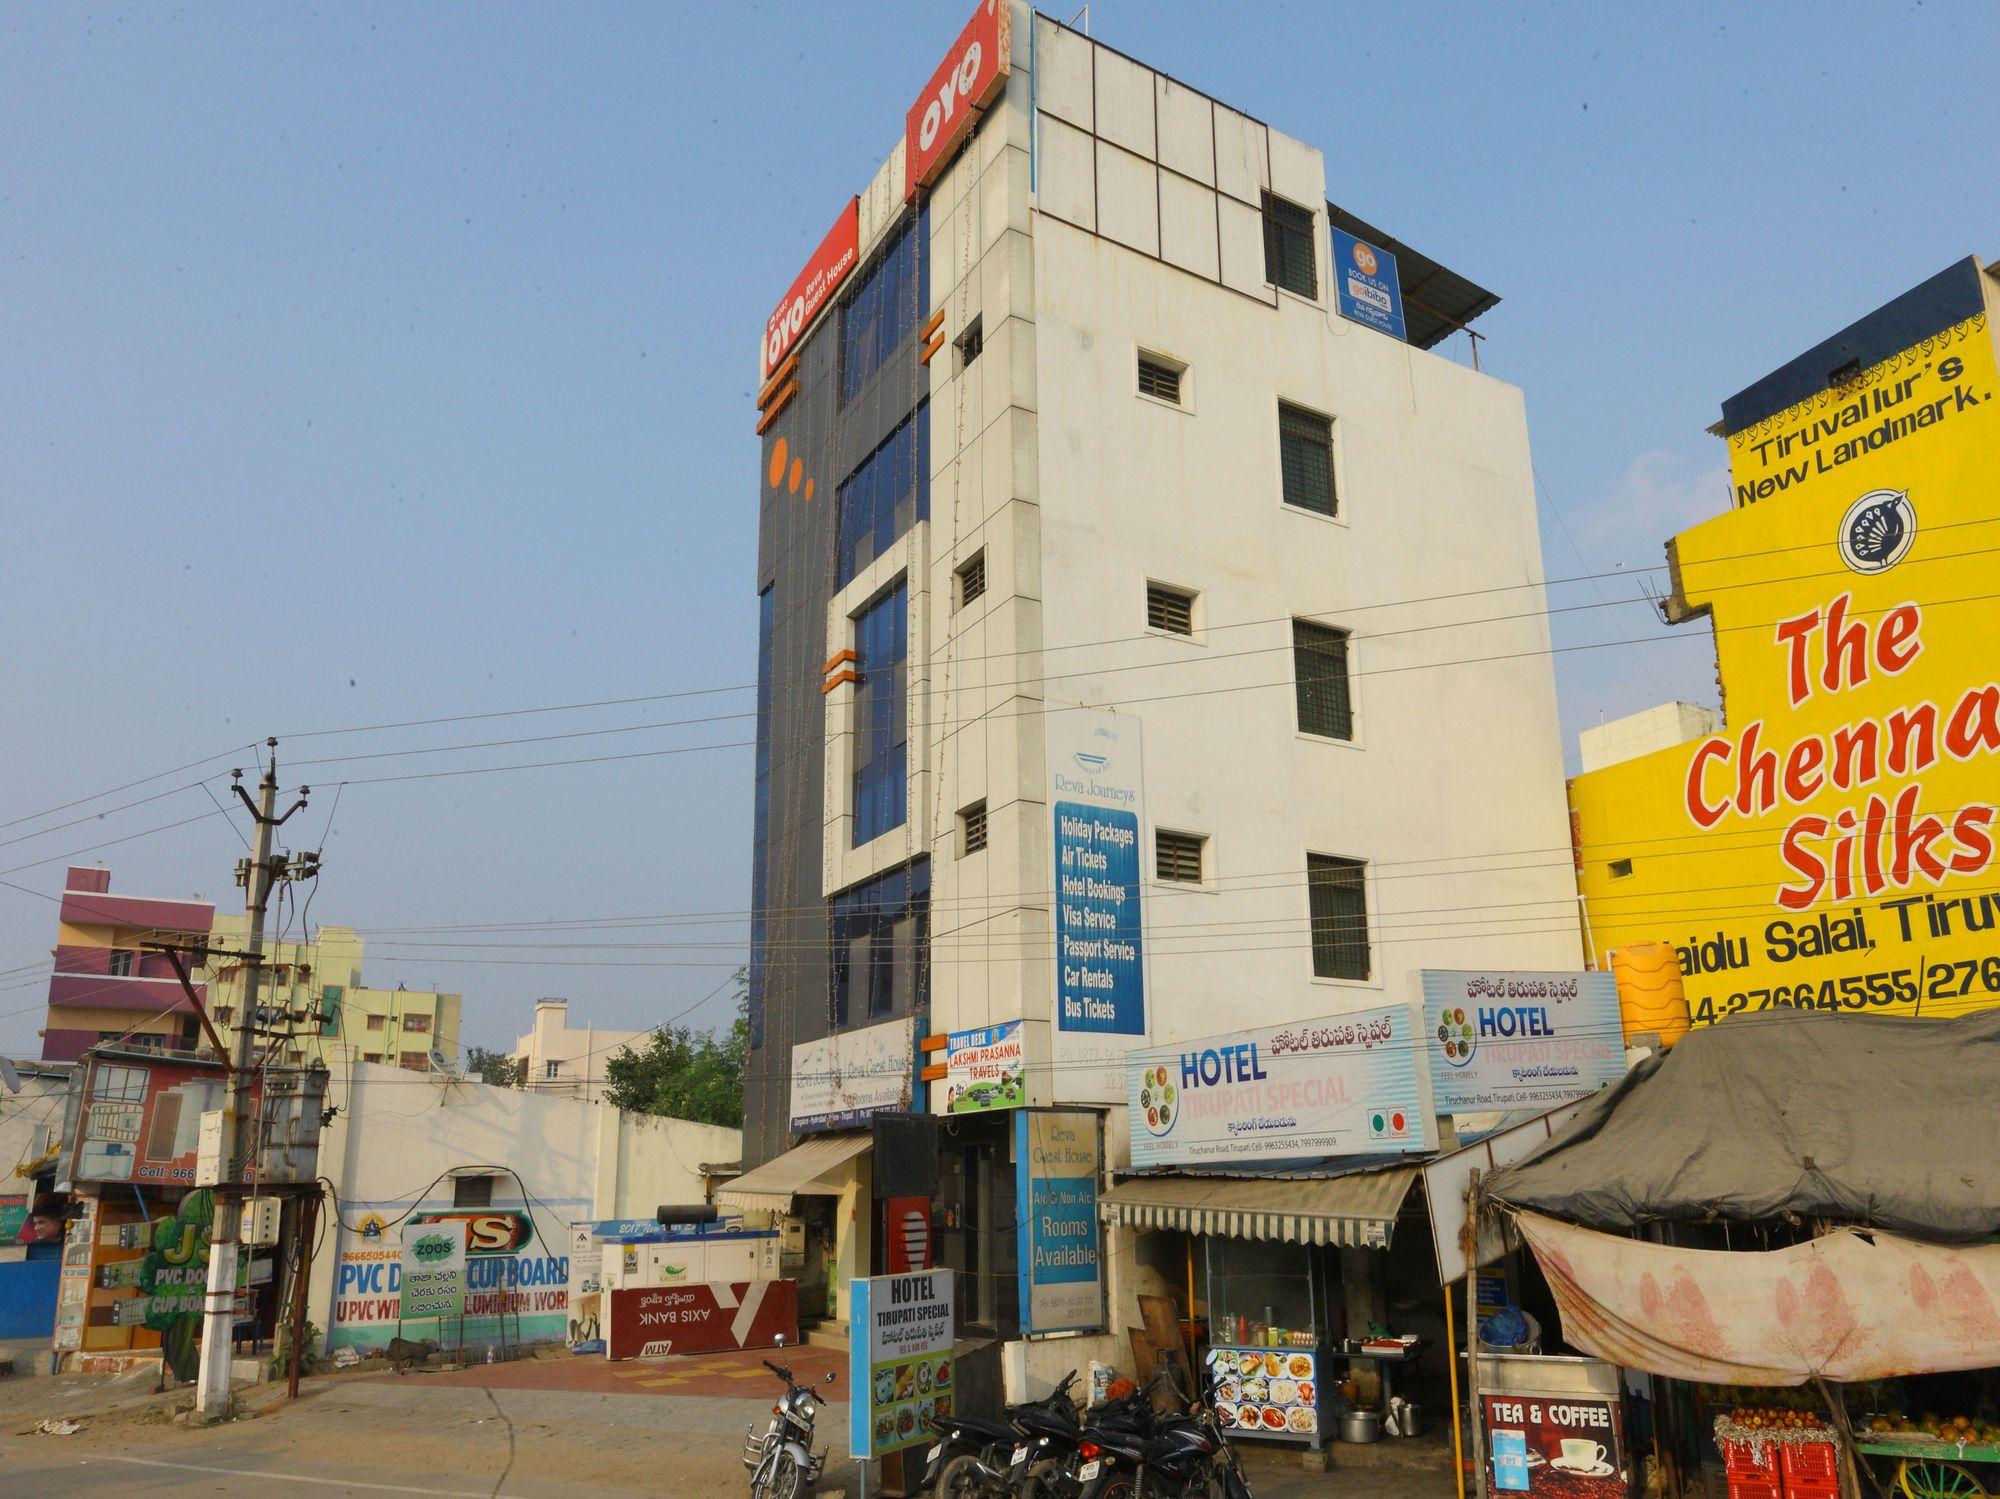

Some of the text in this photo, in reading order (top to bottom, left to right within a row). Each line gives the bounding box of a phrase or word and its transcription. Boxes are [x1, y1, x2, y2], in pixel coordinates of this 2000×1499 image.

[919, 41, 982, 152] OYO
[805, 247, 853, 316] Guest House
[768, 295, 805, 365] OYO
[1750, 356, 1965, 467] Tiruvallur's
[1737, 384, 1992, 508] New Landmark.
[1776, 592, 1923, 709] The
[1055, 773, 1135, 806] Reva Journeys
[1061, 815, 1134, 848] Holiday Packages
[1062, 845, 1107, 870] Air Tickets
[1774, 783, 1998, 911] Silks
[1062, 875, 1125, 905] Hotel Bookings
[1062, 904, 1116, 930] Visa Service
[1063, 935, 1135, 962] Passport Service
[1672, 931, 1750, 977] aidu
[1764, 907, 1876, 963] Salai,
[1064, 965, 1114, 990] Car Rentals
[1467, 977, 1506, 998] హోటల్
[1508, 981, 1547, 998] తిరుపతి
[1065, 996, 1115, 1020] Bus Tickets
[1479, 1007, 1555, 1037] HOTEL
[950, 1034, 969, 1050] TRAVEL
[1271, 1029, 1309, 1055] హోటల్
[1311, 1025, 1355, 1050] తిరుపతి
[1483, 1042, 1552, 1063] TIRUPATI
[949, 1043, 1021, 1067] LAKSHMI PRASANNA
[1180, 1042, 1267, 1090] HOTEL
[969, 1063, 1000, 1080] TRAVELS
[1455, 1070, 1479, 1080] HOMELY
[1181, 1076, 1352, 1120] TIRUPATI SPECIAL
[1444, 1095, 1476, 1105] Tiruchanur
[1051, 1125, 1076, 1142] Reva
[1033, 1149, 1093, 1164] Guest House
[139, 1166, 167, 1177] Cell:
[1060, 1192, 1076, 1205] Non
[619, 1223, 640, 1234] 2017
[1042, 1216, 1088, 1238] Rooms
[417, 1243, 451, 1255] ZOOS
[1034, 1246, 1096, 1267] Available
[155, 1269, 183, 1286] PVC
[338, 1263, 384, 1295] PVC
[467, 1258, 505, 1290] CUP
[506, 1256, 569, 1288] BOARD
[891, 1276, 935, 1304] HOTEL
[152, 1297, 178, 1314] CUP
[464, 1291, 530, 1316] LUMINIUM
[877, 1303, 950, 1327] TIRUPATI SPECIAL
[639, 1309, 711, 1326] AXIS BANK
[645, 1343, 670, 1355] ATM
[1492, 1402, 1609, 1428] TEA & COFFEE
